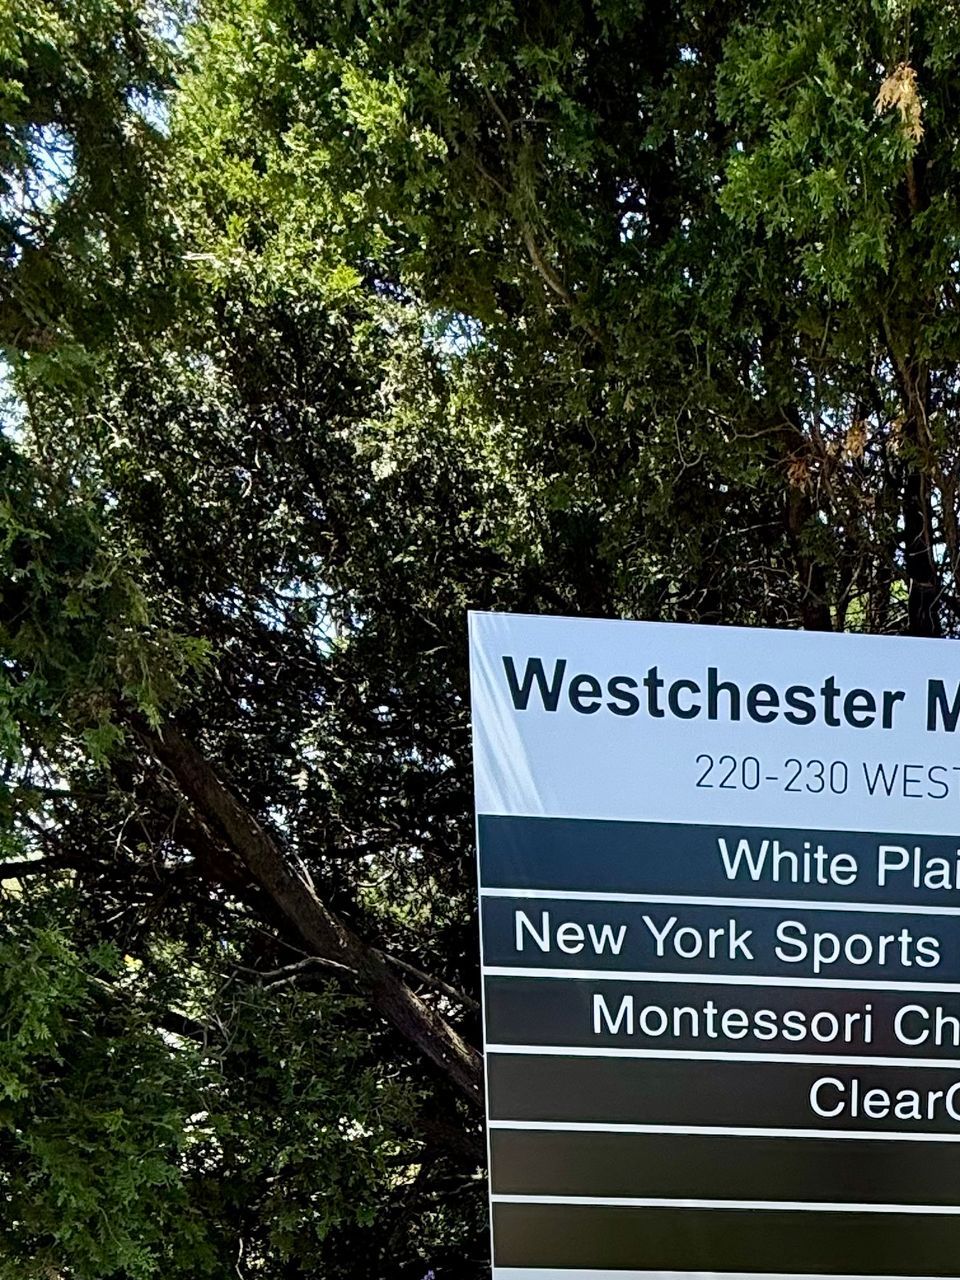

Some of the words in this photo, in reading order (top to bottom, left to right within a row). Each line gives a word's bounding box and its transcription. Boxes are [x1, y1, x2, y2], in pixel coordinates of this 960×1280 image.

[501, 655, 906, 730] Westchester
[695, 754, 848, 795] 220-230
[717, 837, 858, 886] White
[515, 910, 627, 955] New
[641, 915, 754, 960] York
[774, 920, 941, 974] Sports
[593, 993, 872, 1043] Montessori
